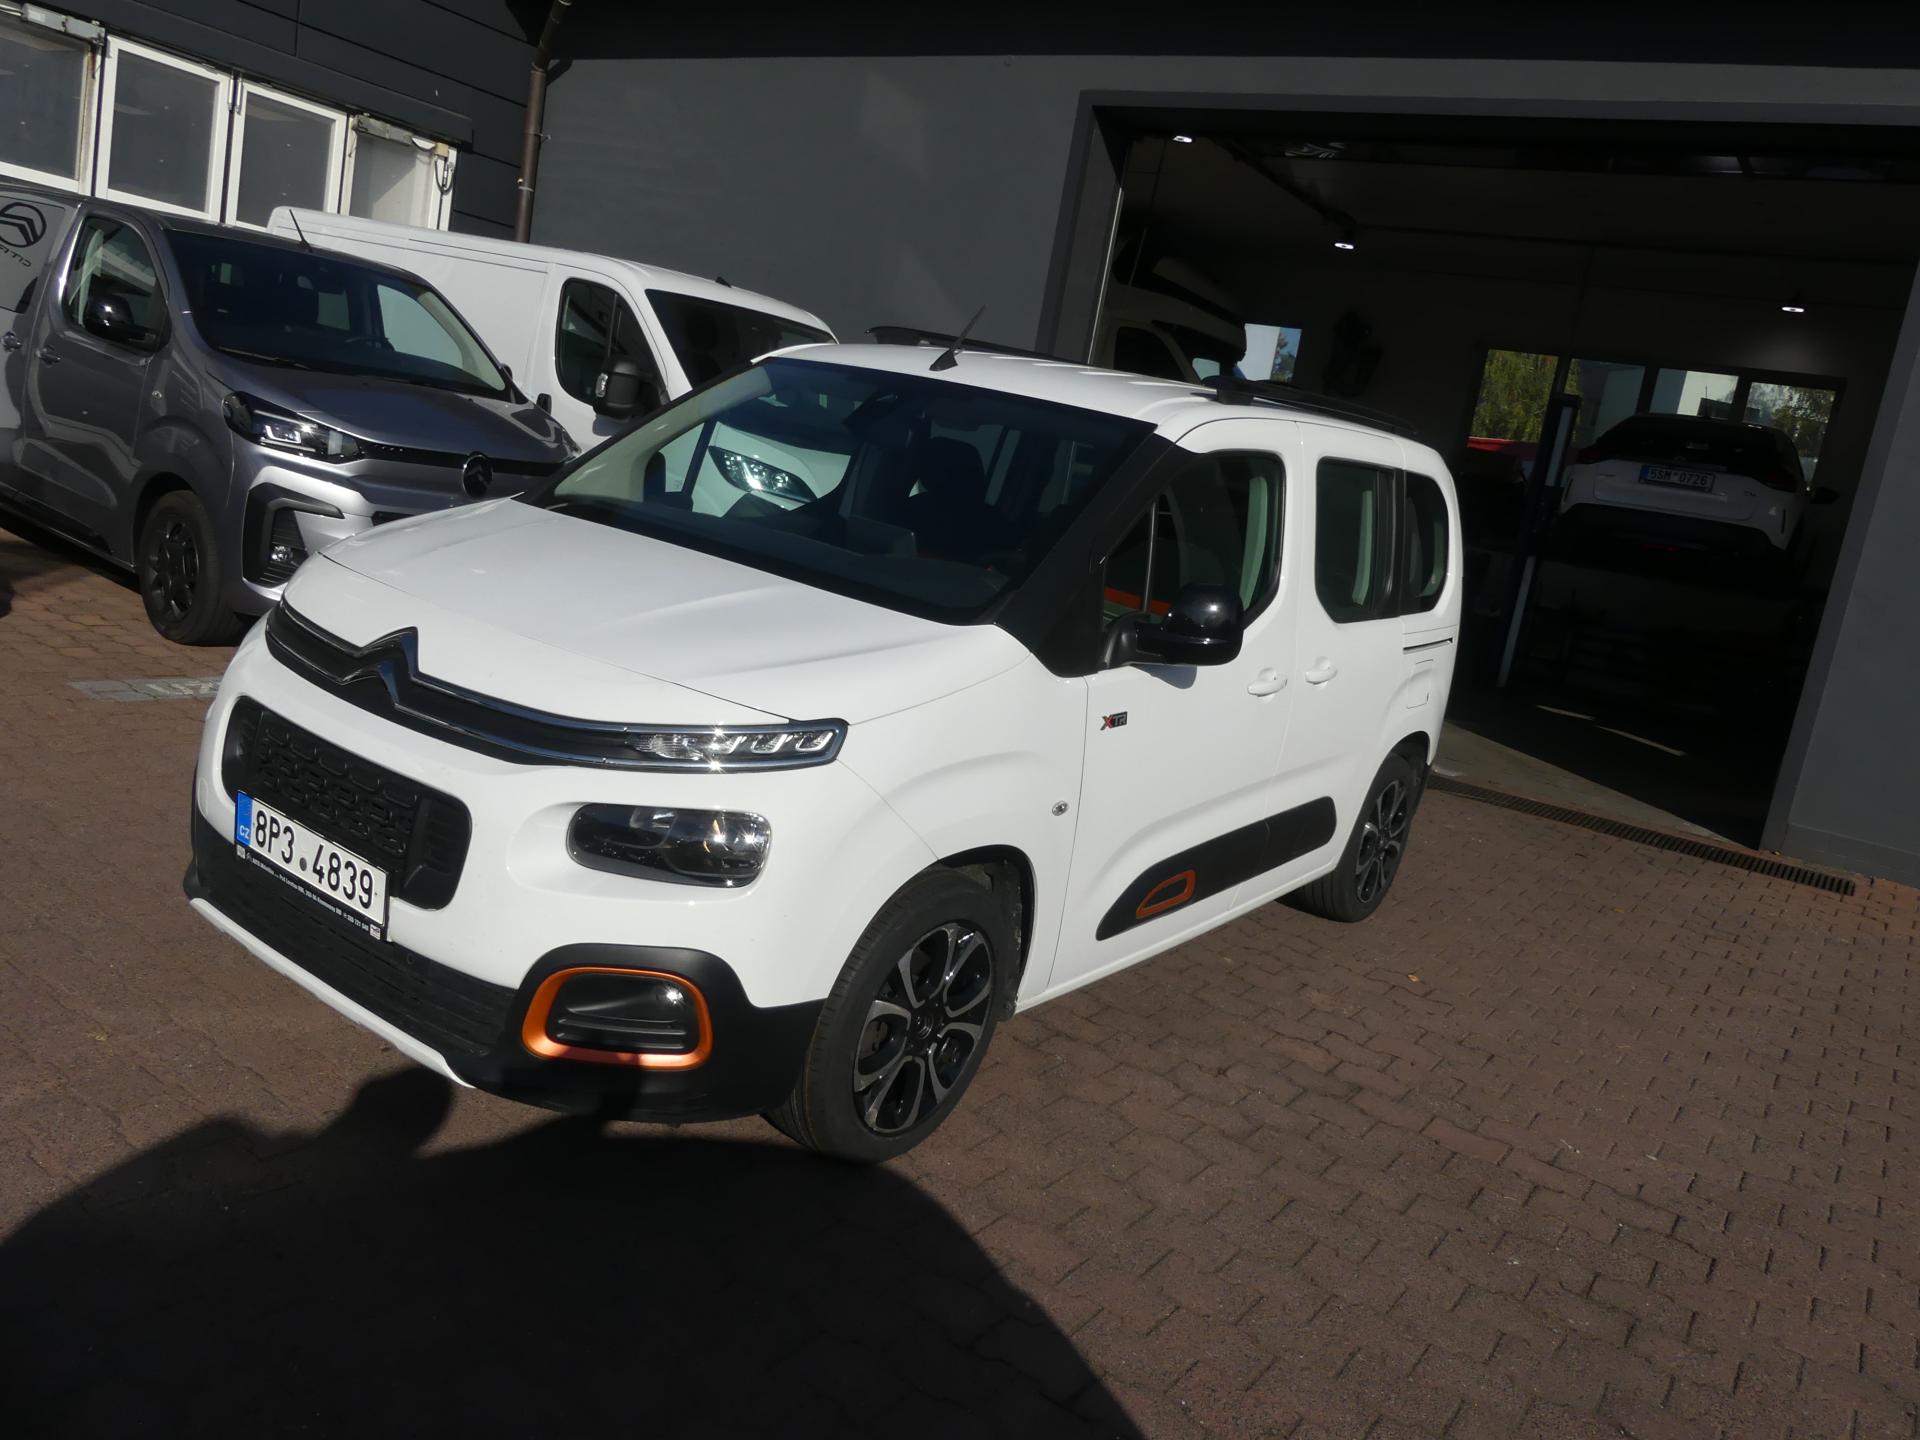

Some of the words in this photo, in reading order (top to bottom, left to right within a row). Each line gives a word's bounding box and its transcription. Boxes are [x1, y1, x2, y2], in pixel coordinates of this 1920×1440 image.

[1100, 711, 1128, 731] XTR
[239, 825, 250, 840] CZ
[255, 810, 295, 864] 8P3
[312, 844, 374, 909] 4839
